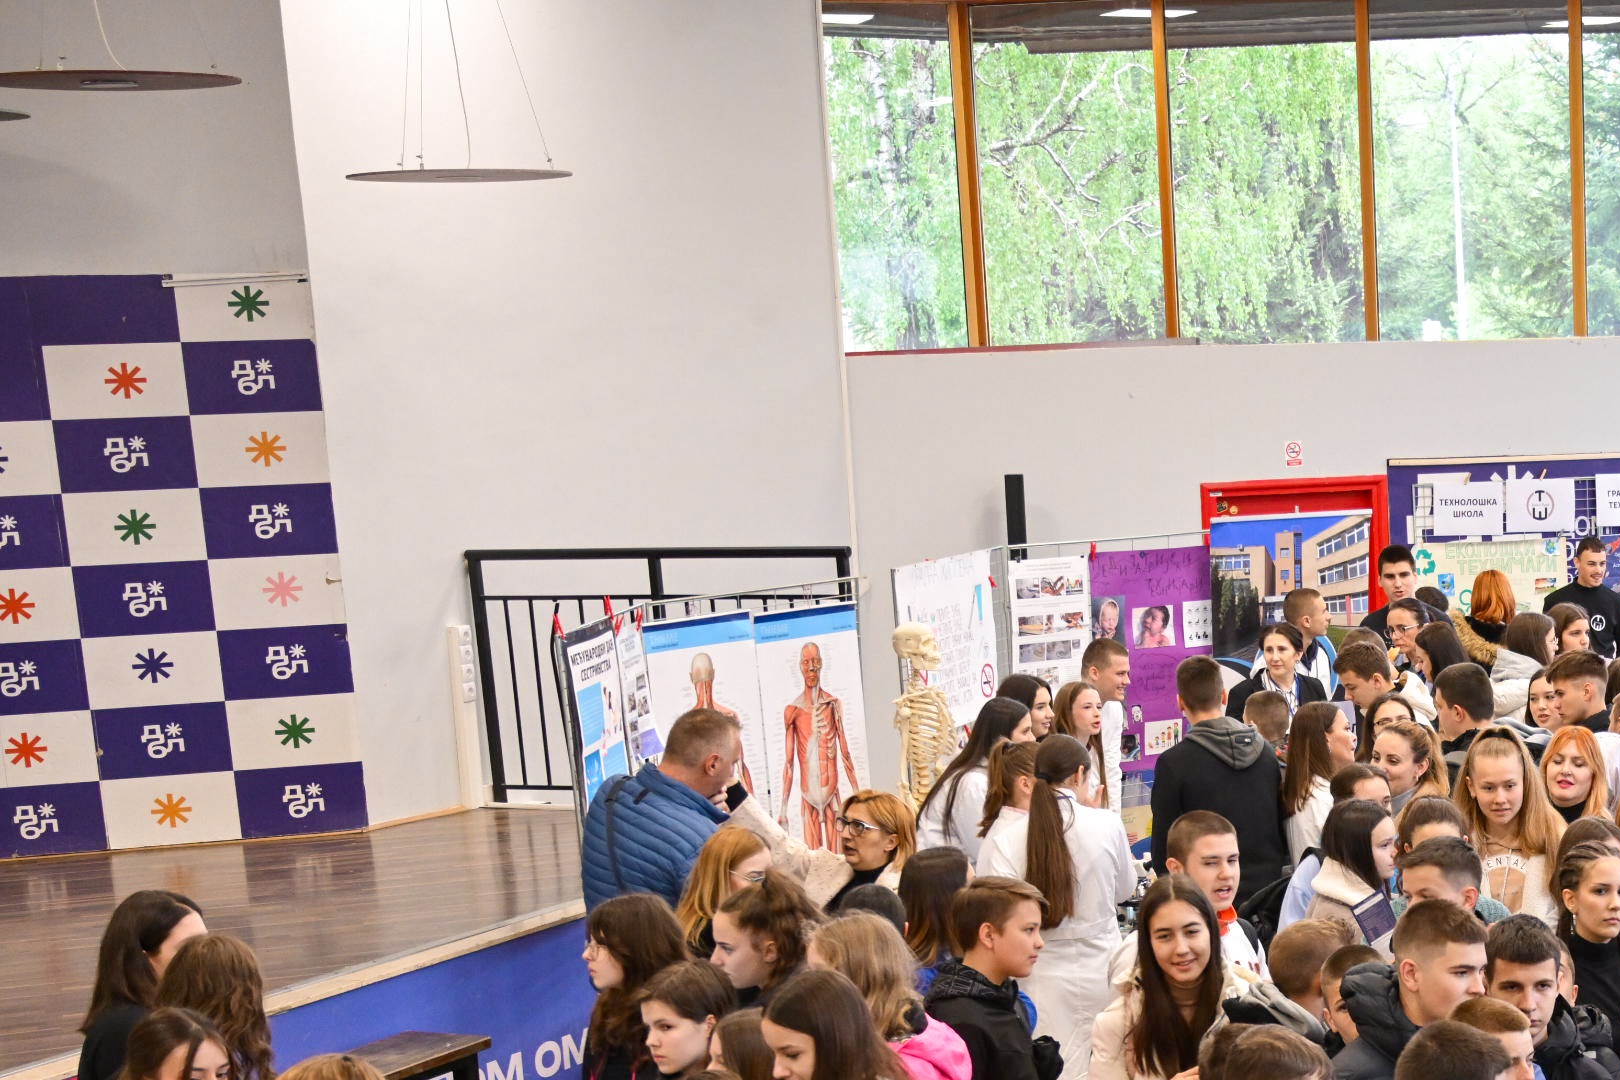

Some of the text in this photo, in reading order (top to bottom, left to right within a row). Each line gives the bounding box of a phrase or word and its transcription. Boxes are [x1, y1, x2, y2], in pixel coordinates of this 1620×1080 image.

[1439, 498, 1497, 507] ТЕХНОЛОШКА
[1453, 510, 1484, 518] ШКОЛА
[570, 643, 606, 666] МЕЂУНАРОДНИ
